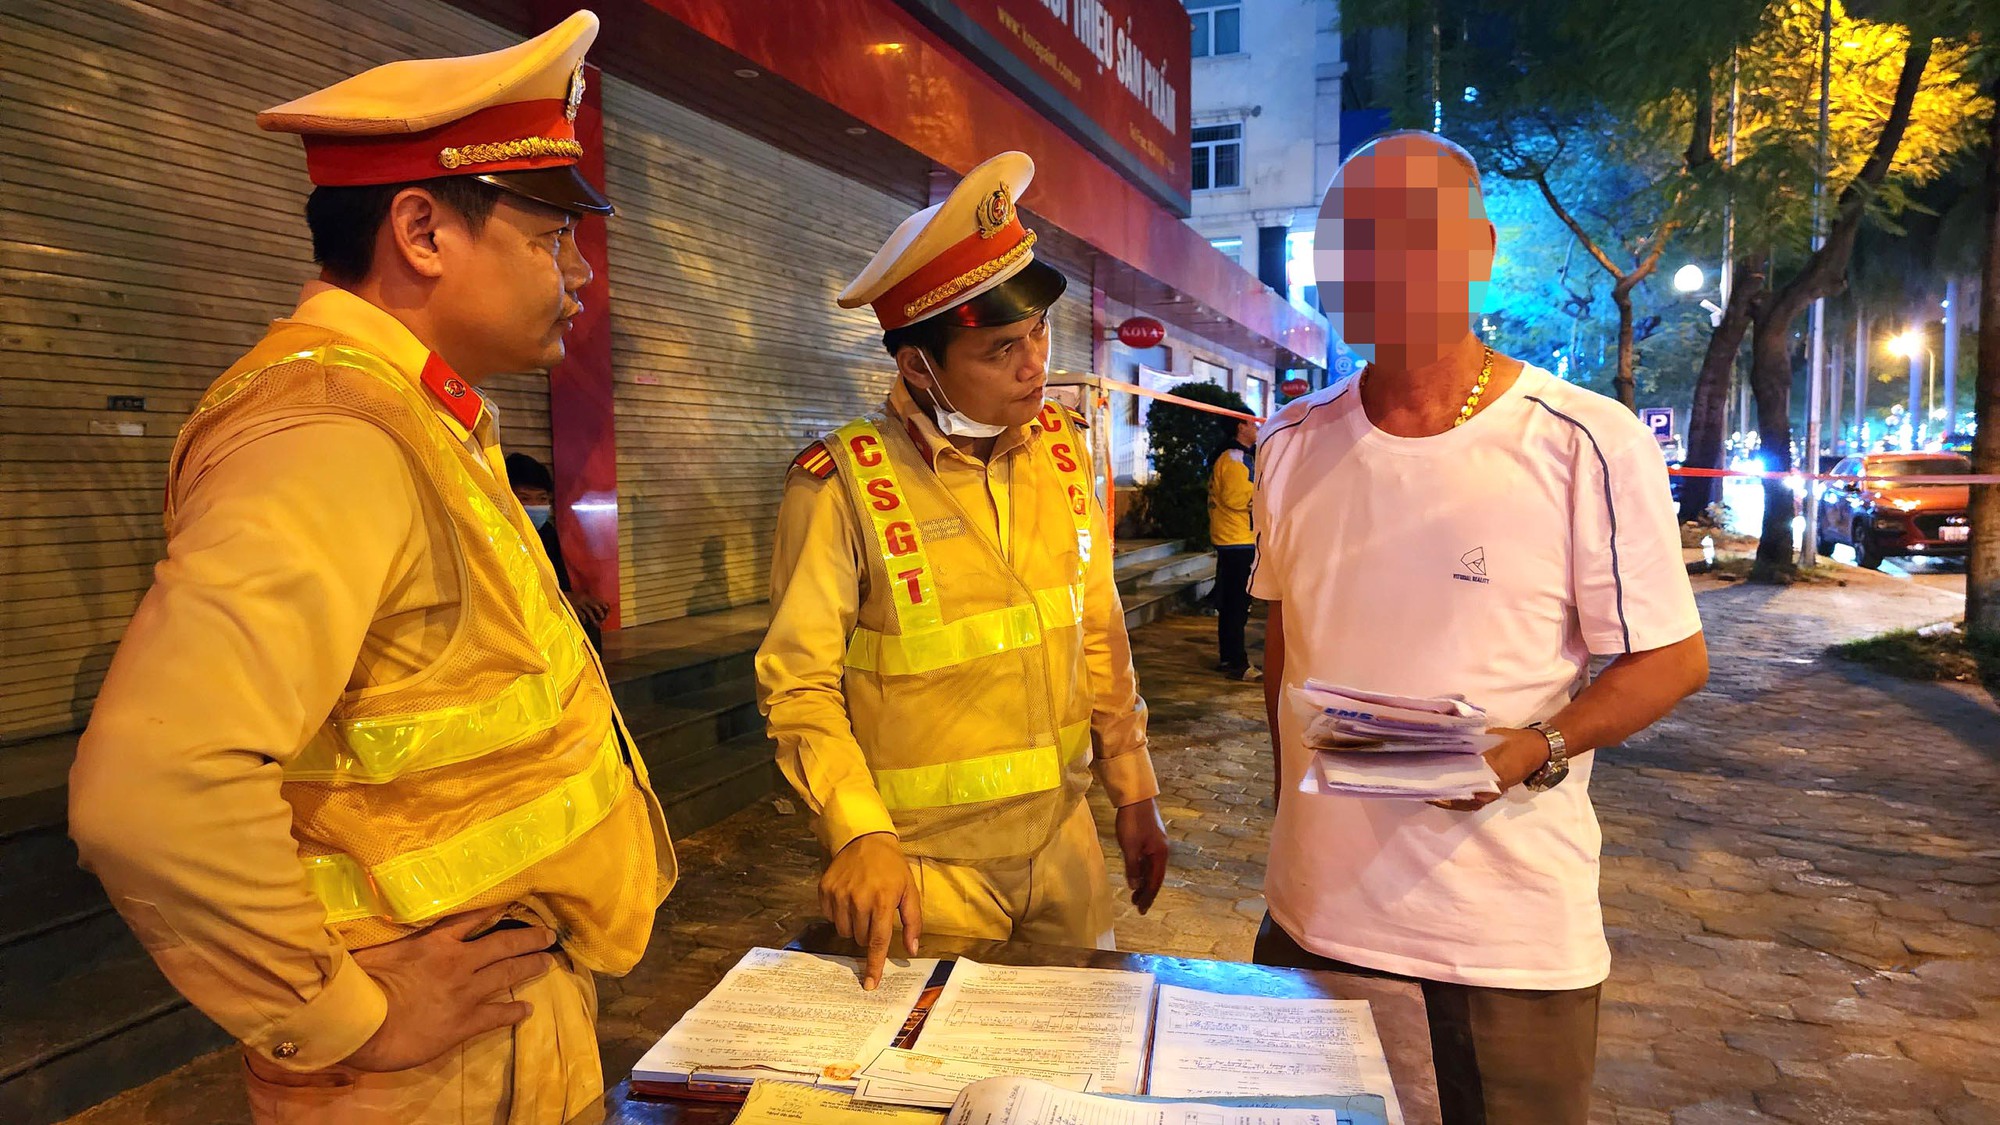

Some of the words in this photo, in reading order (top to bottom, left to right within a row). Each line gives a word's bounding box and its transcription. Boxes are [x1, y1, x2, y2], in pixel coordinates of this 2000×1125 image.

[1116, 15, 1142, 101] SẢN
[1038, 404, 1087, 516] CSG
[1650, 414, 1668, 435] P
[850, 435, 924, 605] CSGT
[1324, 707, 1374, 720] EMS
